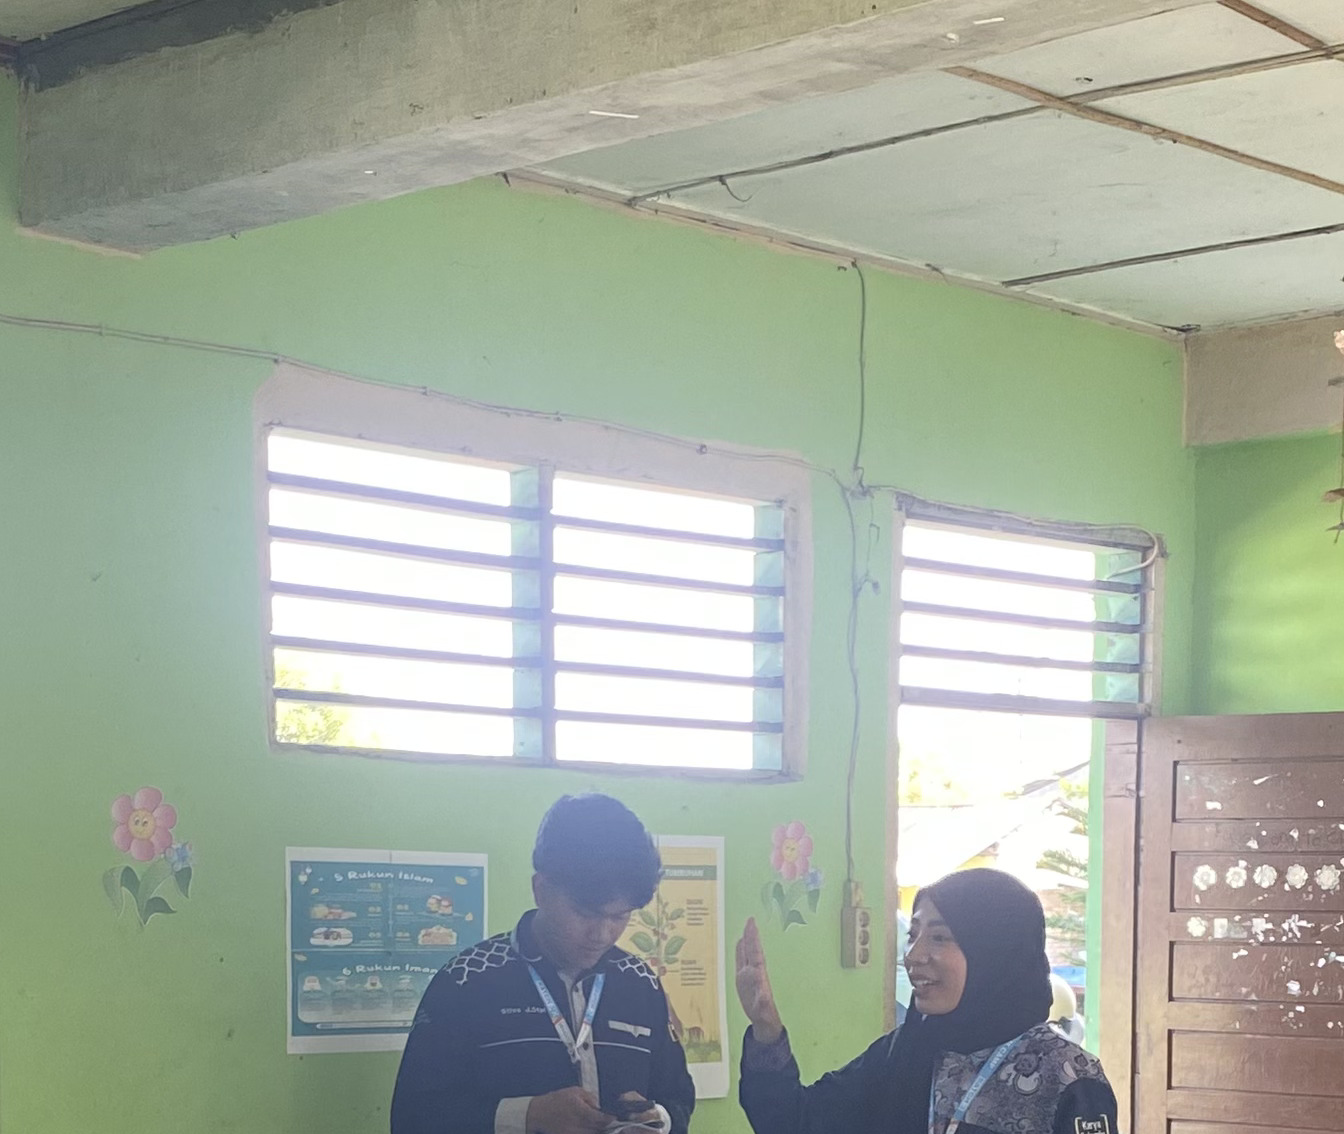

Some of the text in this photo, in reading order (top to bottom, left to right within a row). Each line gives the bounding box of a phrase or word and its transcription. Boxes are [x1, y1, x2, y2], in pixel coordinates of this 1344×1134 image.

[347, 870, 394, 880] Rukun
[398, 870, 434, 884] Islam
[342, 963, 438, 976] 6 Rukun Iman
